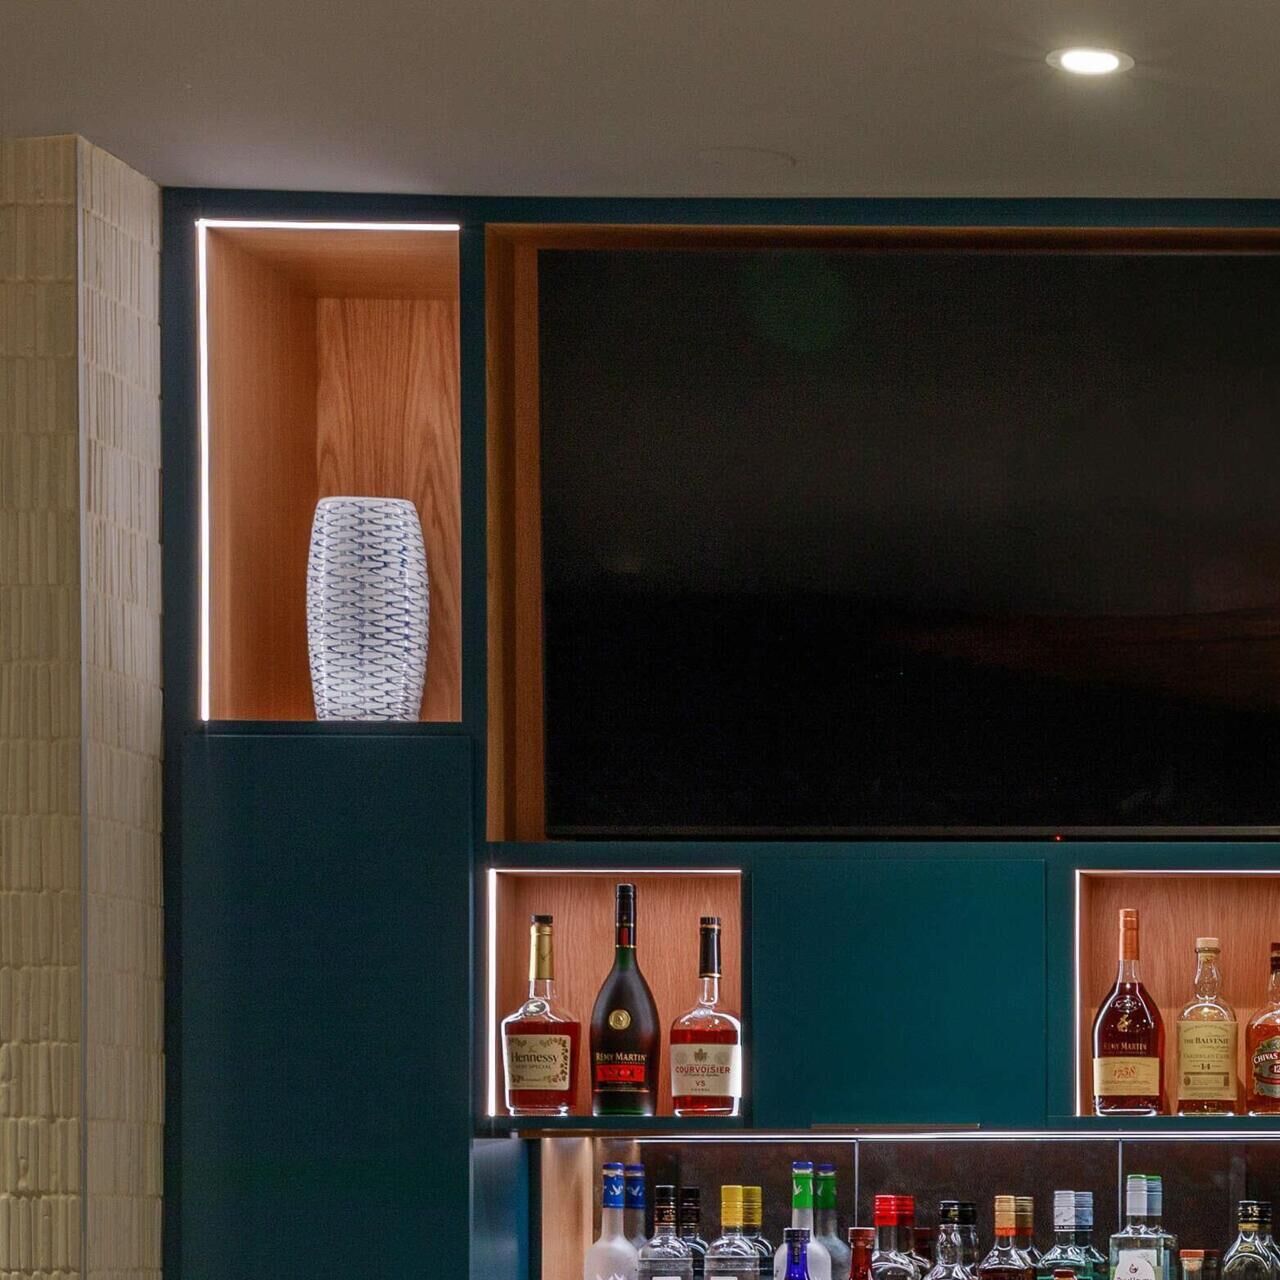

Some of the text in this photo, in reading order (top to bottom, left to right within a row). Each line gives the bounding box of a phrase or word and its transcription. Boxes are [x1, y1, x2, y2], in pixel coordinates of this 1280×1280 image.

[511, 1052, 558, 1065] Hennessy
[615, 1051, 646, 1061] MARTIN
[1253, 1051, 1278, 1064] CHIVAS
[675, 1065, 731, 1074] COURVOISIER
